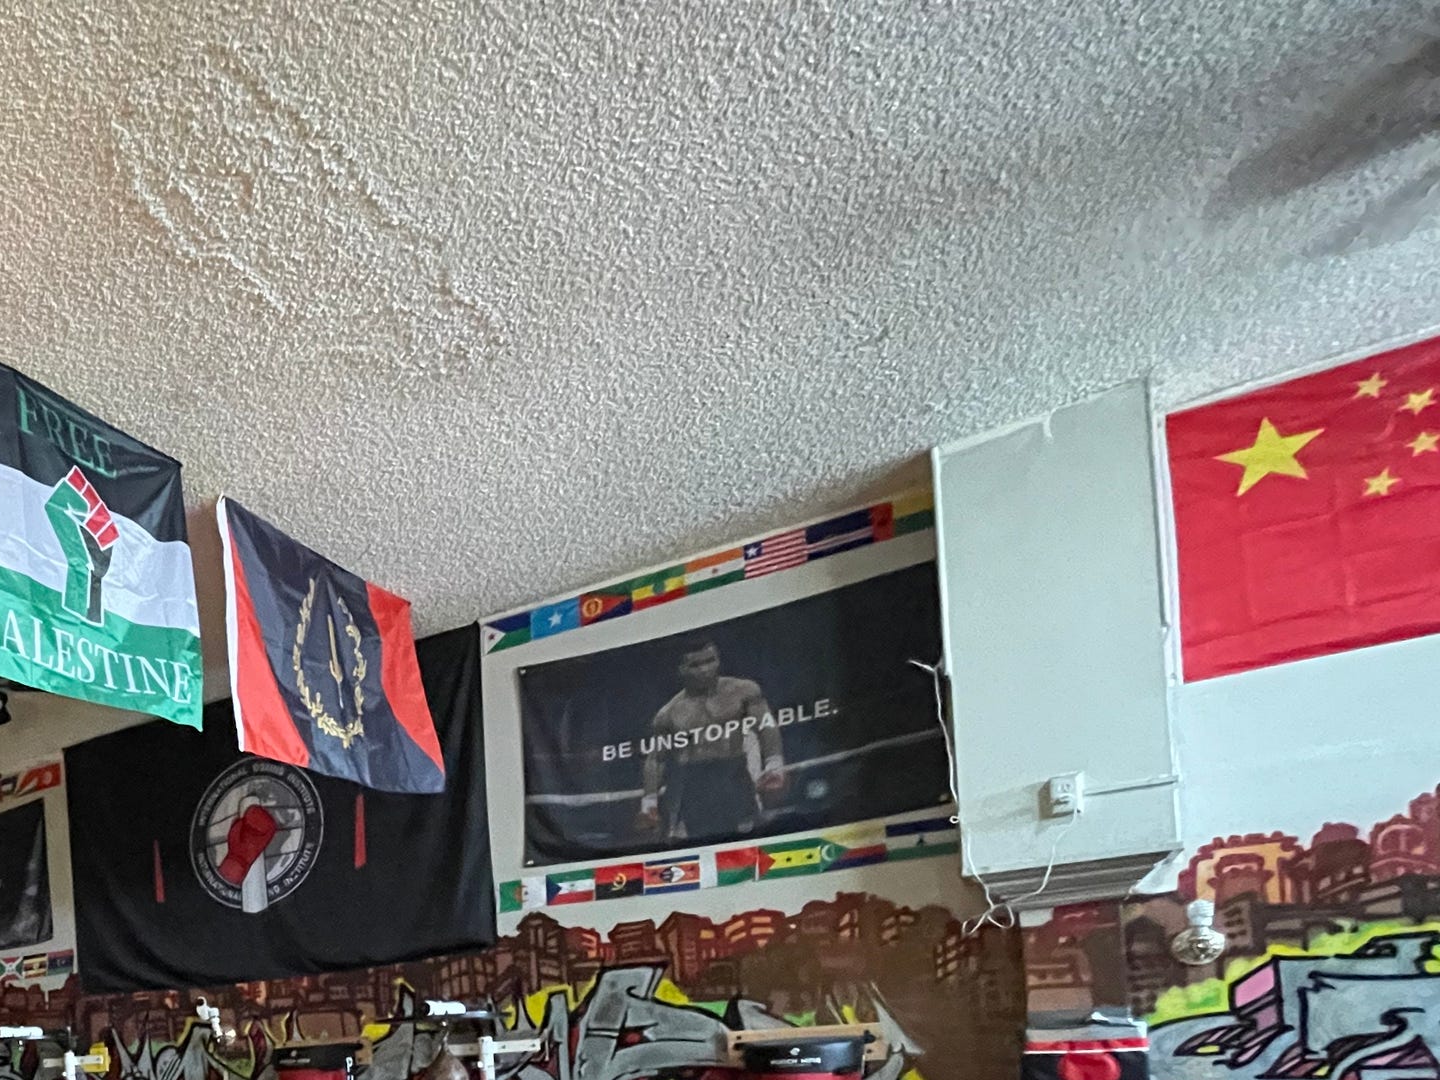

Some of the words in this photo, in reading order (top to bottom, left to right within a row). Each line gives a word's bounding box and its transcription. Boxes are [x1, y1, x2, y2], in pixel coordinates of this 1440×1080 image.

[16, 387, 118, 478] FREE
[601, 740, 633, 762] BE
[640, 698, 840, 755] UNSTOPPABLE.
